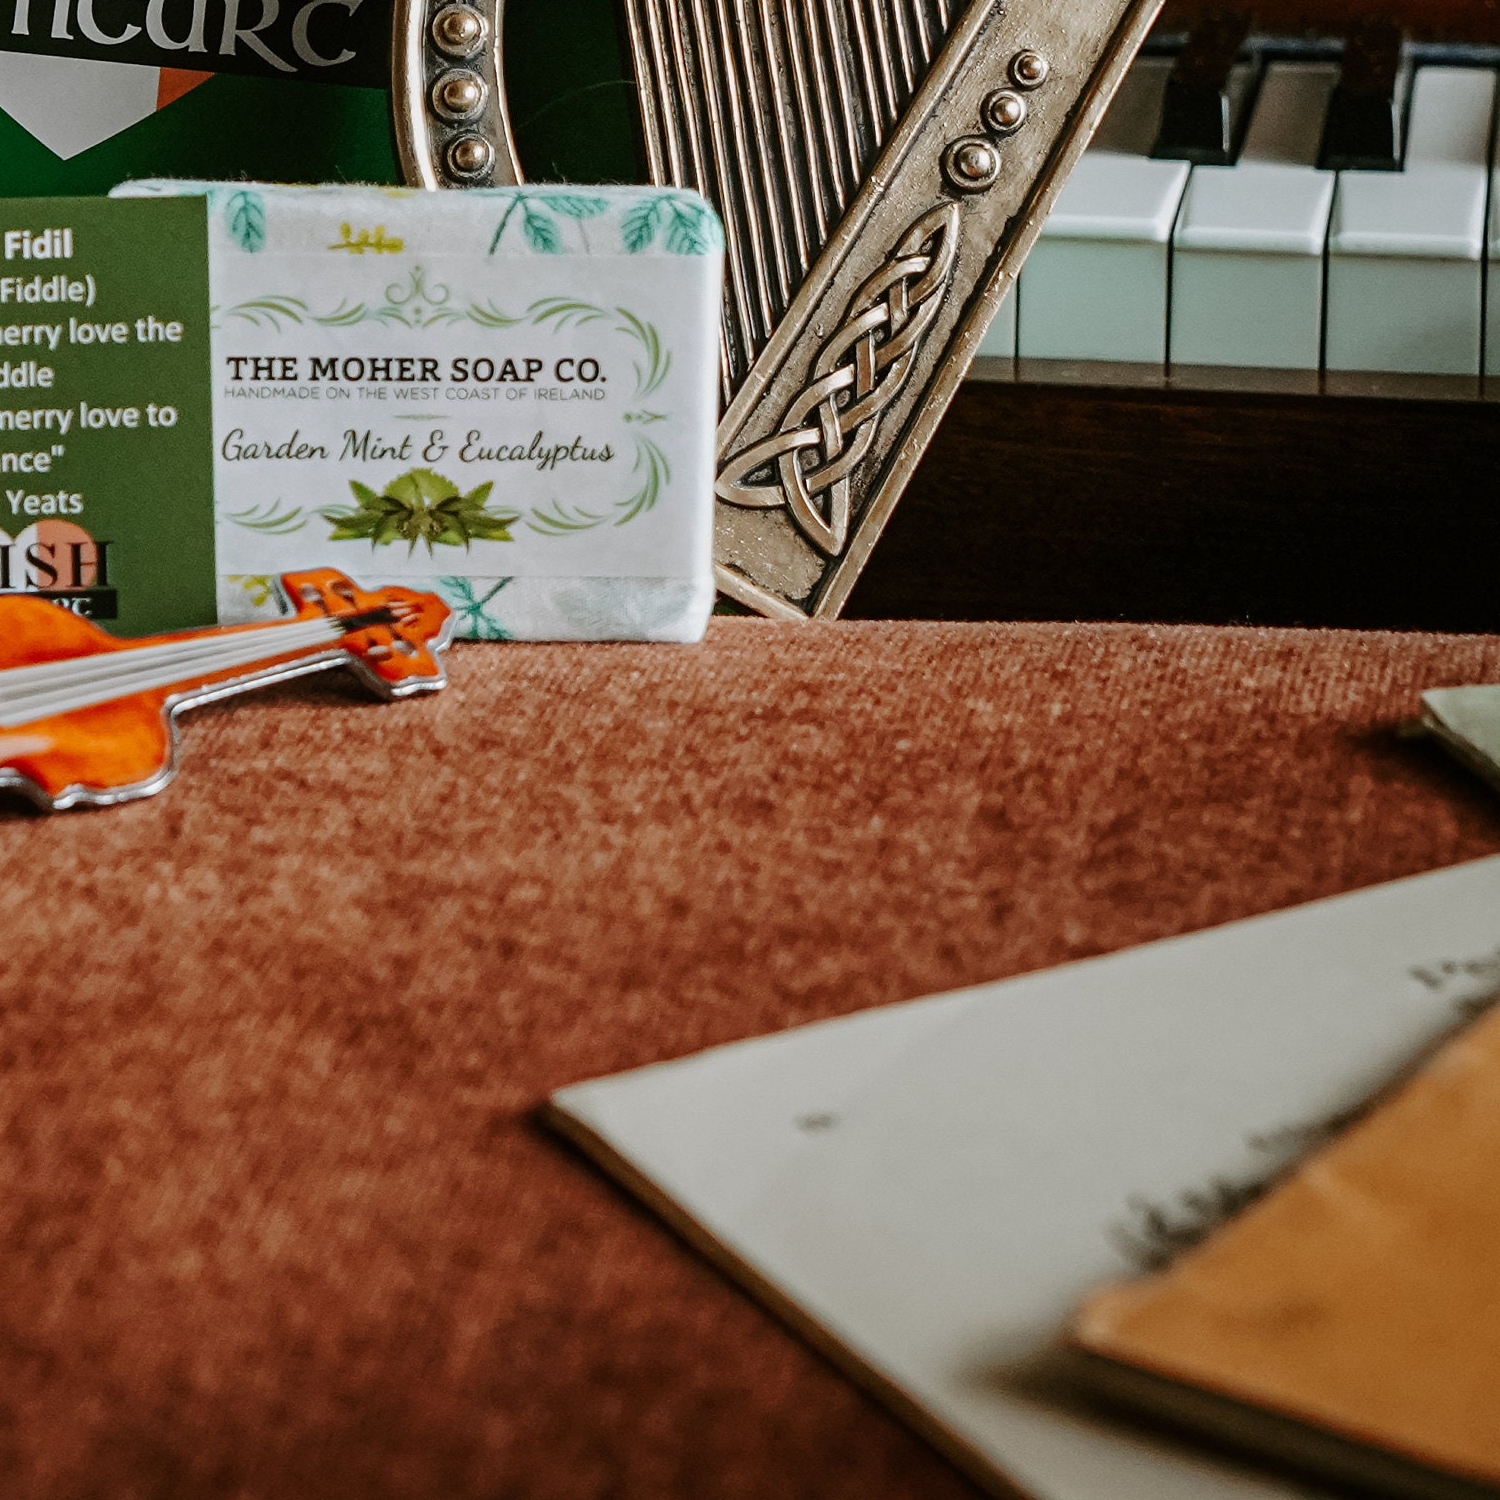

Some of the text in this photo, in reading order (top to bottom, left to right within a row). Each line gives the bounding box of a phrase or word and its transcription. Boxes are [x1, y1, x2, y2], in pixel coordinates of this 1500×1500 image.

[4, 229, 73, 260] Fidil
[0, 274, 96, 306] Fiddle)
[69, 318, 126, 344] love
[135, 317, 183, 343] the
[227, 356, 607, 383] THE MOHER SOAP CO.
[224, 386, 606, 401] HANDMADE ON THE WEST COAST OF IRELAND
[80, 404, 139, 428] love
[146, 404, 177, 427] to
[222, 429, 614, 470] Garden Mint & Eucalyptus
[4, 490, 83, 515] Yeats
